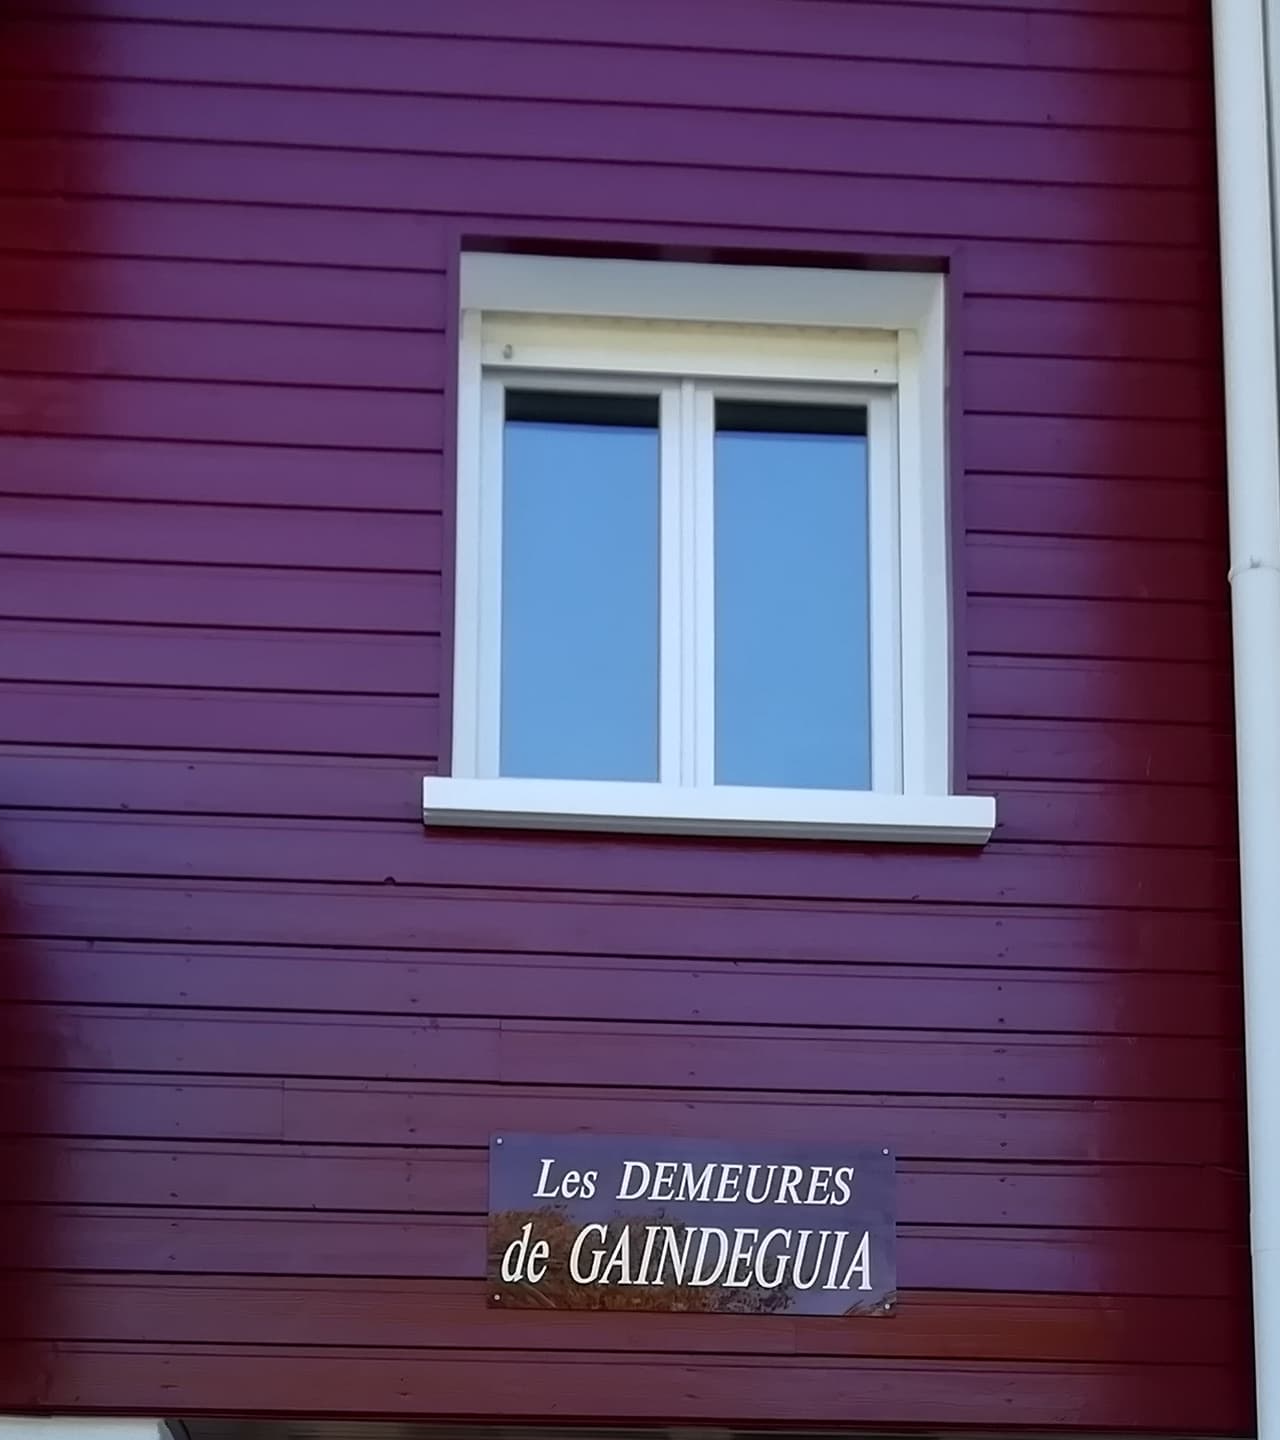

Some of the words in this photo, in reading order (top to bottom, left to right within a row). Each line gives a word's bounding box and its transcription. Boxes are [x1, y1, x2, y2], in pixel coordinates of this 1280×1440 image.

[533, 1158, 598, 1199] Les
[616, 1160, 855, 1206] DEMEURES
[500, 1222, 549, 1284] de
[568, 1223, 873, 1291] GAINDEGUIA
